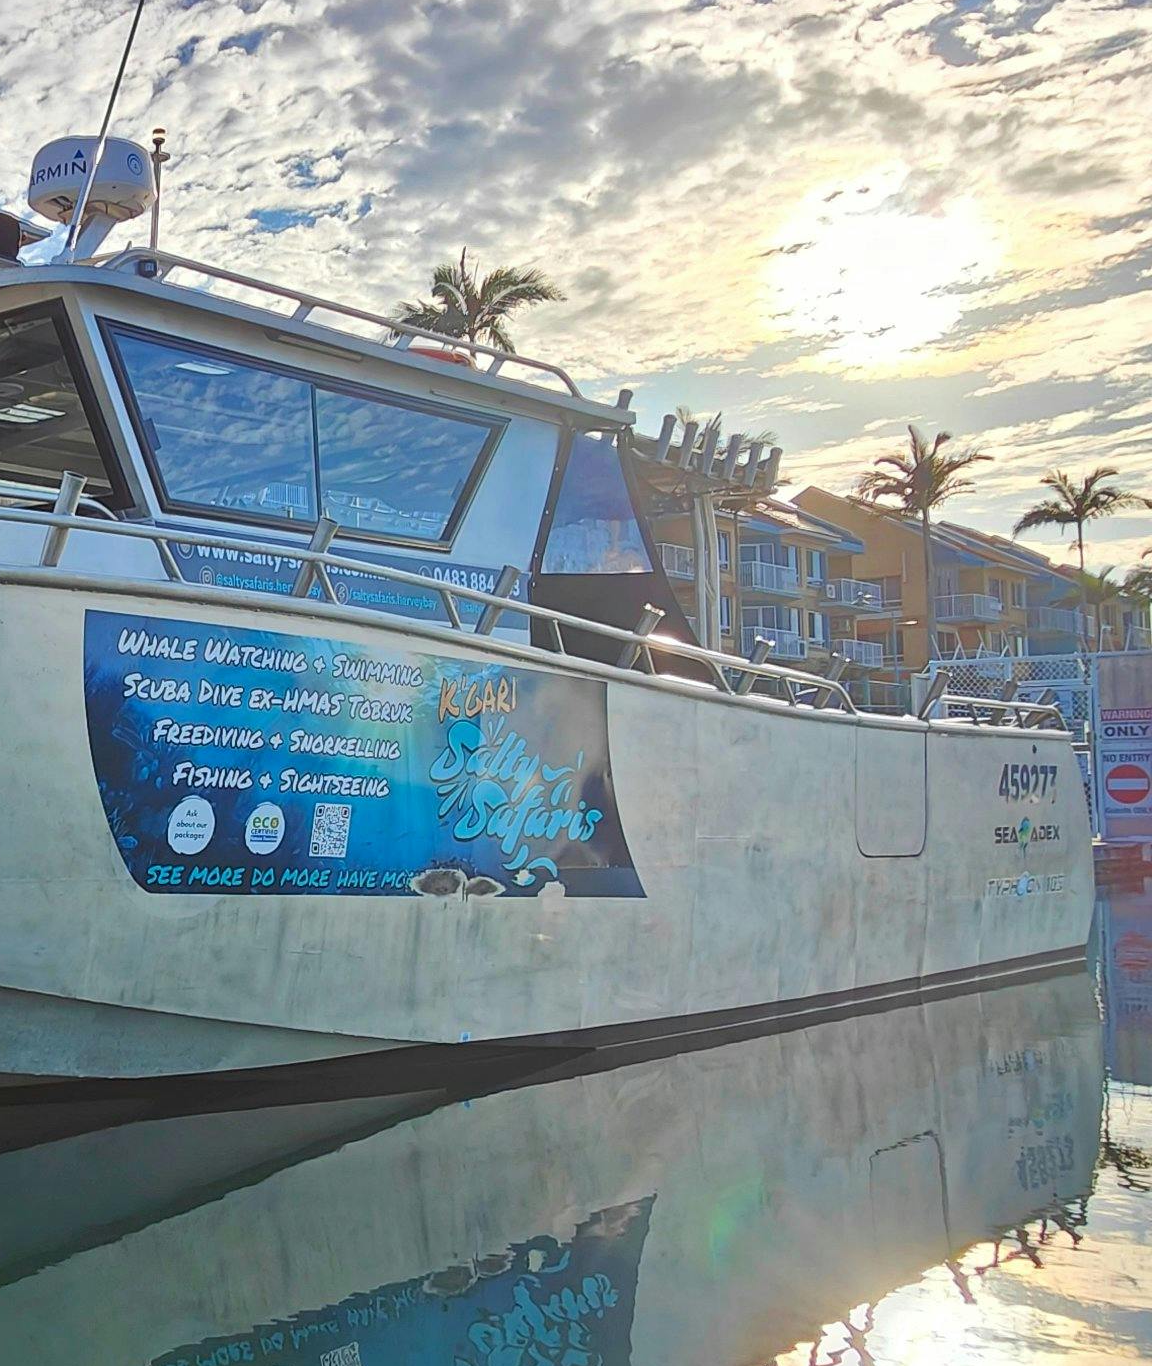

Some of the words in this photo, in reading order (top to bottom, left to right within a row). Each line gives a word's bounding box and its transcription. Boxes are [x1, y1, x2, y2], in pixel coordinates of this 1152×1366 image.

[118, 628, 198, 661] WHALE
[204, 637, 308, 673] WATCHING
[332, 654, 424, 687] SWIMMING
[123, 672, 191, 703] SCUBA
[198, 679, 244, 707] DIVE
[249, 687, 345, 716] EX-HMAS
[348, 694, 413, 724] TOBRUK
[153, 718, 265, 750] FREEDIVING
[289, 729, 401, 760] SNORKELLING
[1104, 725, 1150, 737] ONLY
[429, 719, 540, 804] Salty
[1103, 754, 1117, 763] NO
[1119, 753, 1151, 763] ENTRY
[172, 760, 253, 790] FISHING
[280, 768, 390, 797] SIGHTSEEING
[176, 820, 196, 828] about
[186, 809, 198, 818] Ask
[252, 816, 279, 829] eco
[453, 780, 604, 855] Safaris
[174, 832, 205, 842] packages
[147, 865, 185, 886] SEE
[188, 866, 246, 887] MORE
[251, 868, 275, 887] DO
[280, 868, 331, 888] MORE
[336, 870, 378, 889] HAVE
